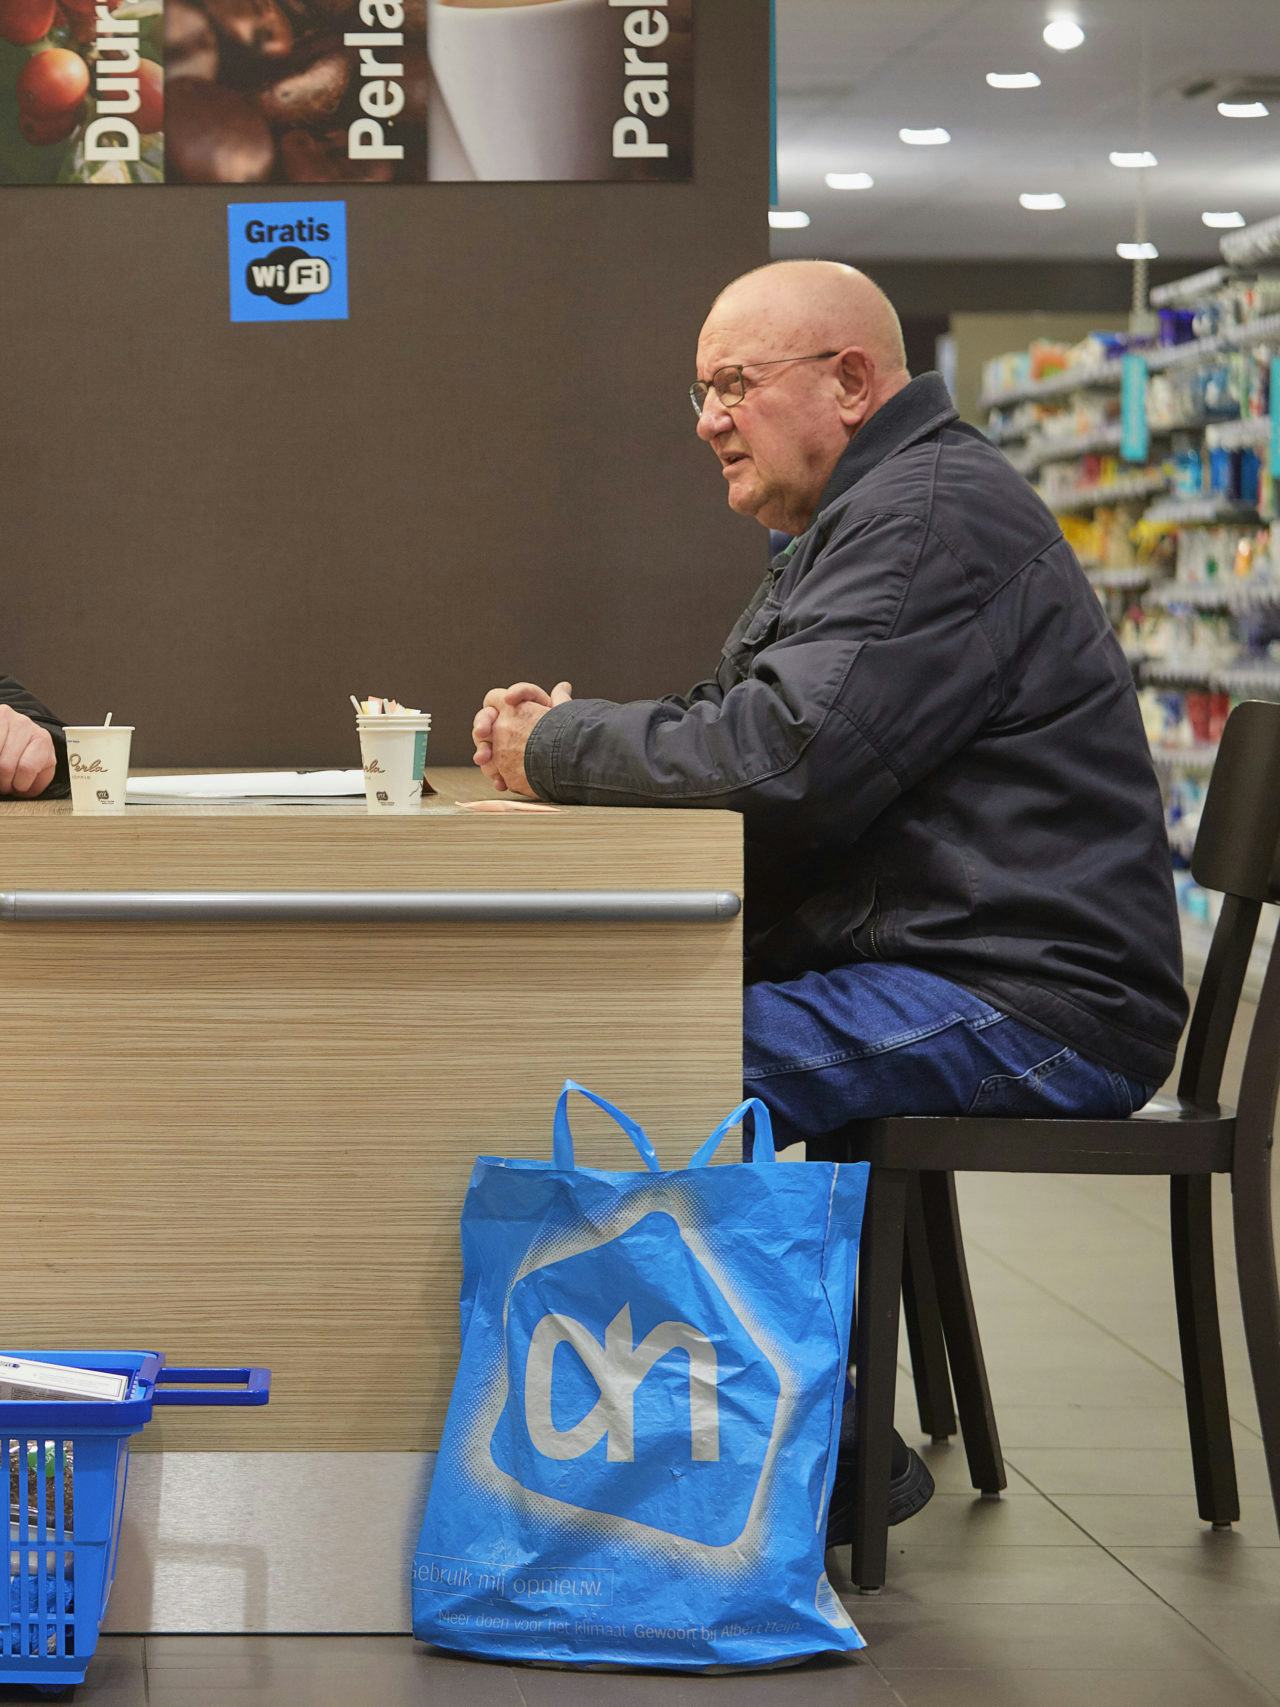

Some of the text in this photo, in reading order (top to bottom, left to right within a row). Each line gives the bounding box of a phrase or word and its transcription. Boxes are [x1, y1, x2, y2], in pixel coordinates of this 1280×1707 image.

[84, 0, 141, 161] Duur
[344, 0, 405, 160] Perla
[245, 217, 330, 243] Gratis
[69, 753, 110, 773] Perla
[363, 760, 386, 773] rla
[478, 1573, 506, 1596] mij
[513, 1577, 603, 1598] opnieuw.
[438, 1608, 472, 1626] Meer
[475, 1612, 510, 1629] doen
[513, 1618, 544, 1633] voor
[548, 1619, 570, 1634] het
[701, 1623, 717, 1642] bij
[720, 1621, 761, 1639] Albert
